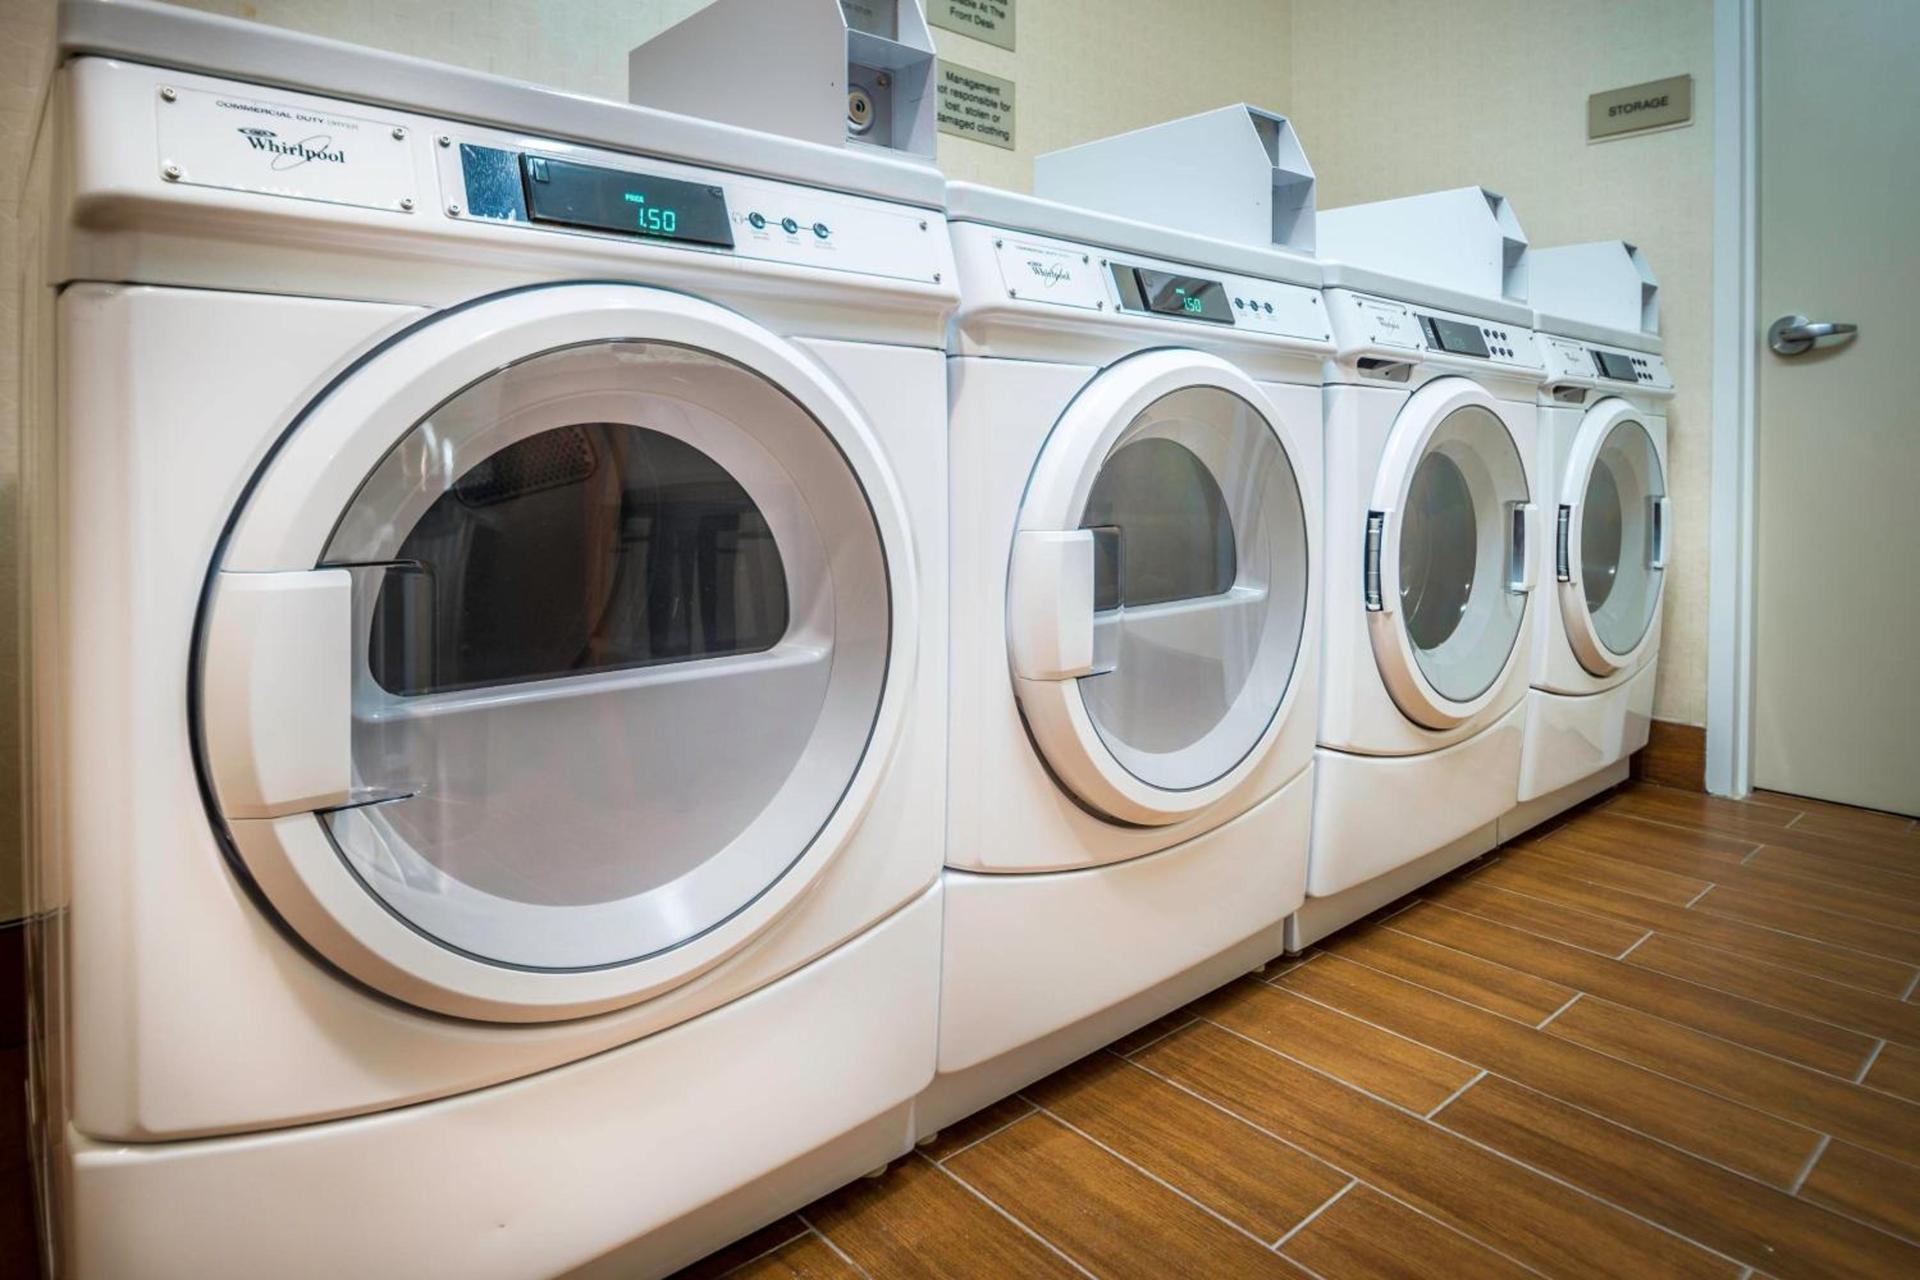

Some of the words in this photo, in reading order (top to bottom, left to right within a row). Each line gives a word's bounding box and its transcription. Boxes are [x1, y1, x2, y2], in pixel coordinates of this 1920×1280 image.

[950, 6, 973, 21] Front
[974, 15, 995, 29] Desk
[990, 5, 1005, 18] The
[946, 71, 1000, 95] Management
[949, 87, 998, 109] responsible
[1000, 101, 1011, 112] for
[1608, 96, 1669, 117] STORAGE
[215, 100, 292, 118] COMMERCIAL
[296, 113, 323, 123] DUTY
[965, 106, 990, 121] stolen
[992, 114, 1001, 123] or
[977, 124, 1010, 141] clothing
[246, 135, 346, 164] Whirlpool
[639, 208, 676, 232] 1.50
[1031, 266, 1071, 282] Whirlpool
